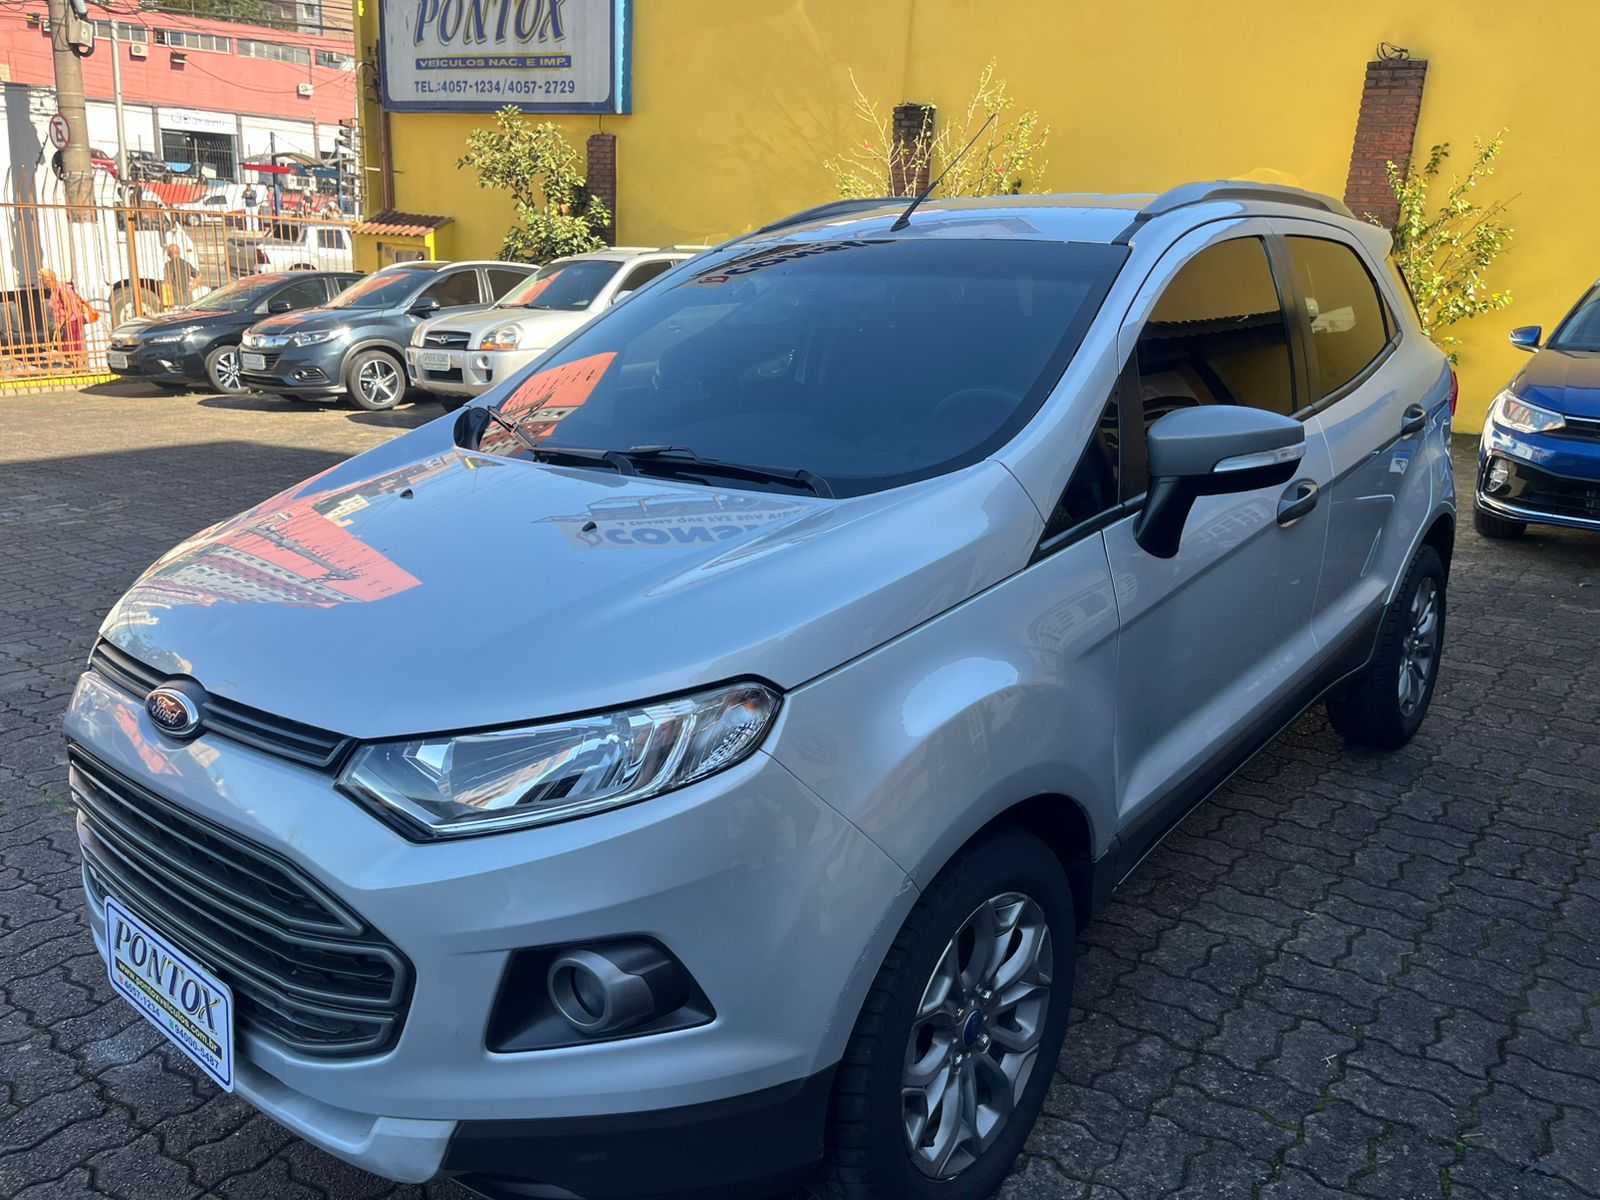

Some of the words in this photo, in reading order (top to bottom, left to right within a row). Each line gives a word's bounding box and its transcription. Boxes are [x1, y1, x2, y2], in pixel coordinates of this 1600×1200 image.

[414, 0, 568, 46] PONTOX
[489, 59, 522, 67] NAC.
[527, 58, 536, 66] E
[540, 57, 568, 66] IMP.
[115, 917, 220, 1035] PONTOX
